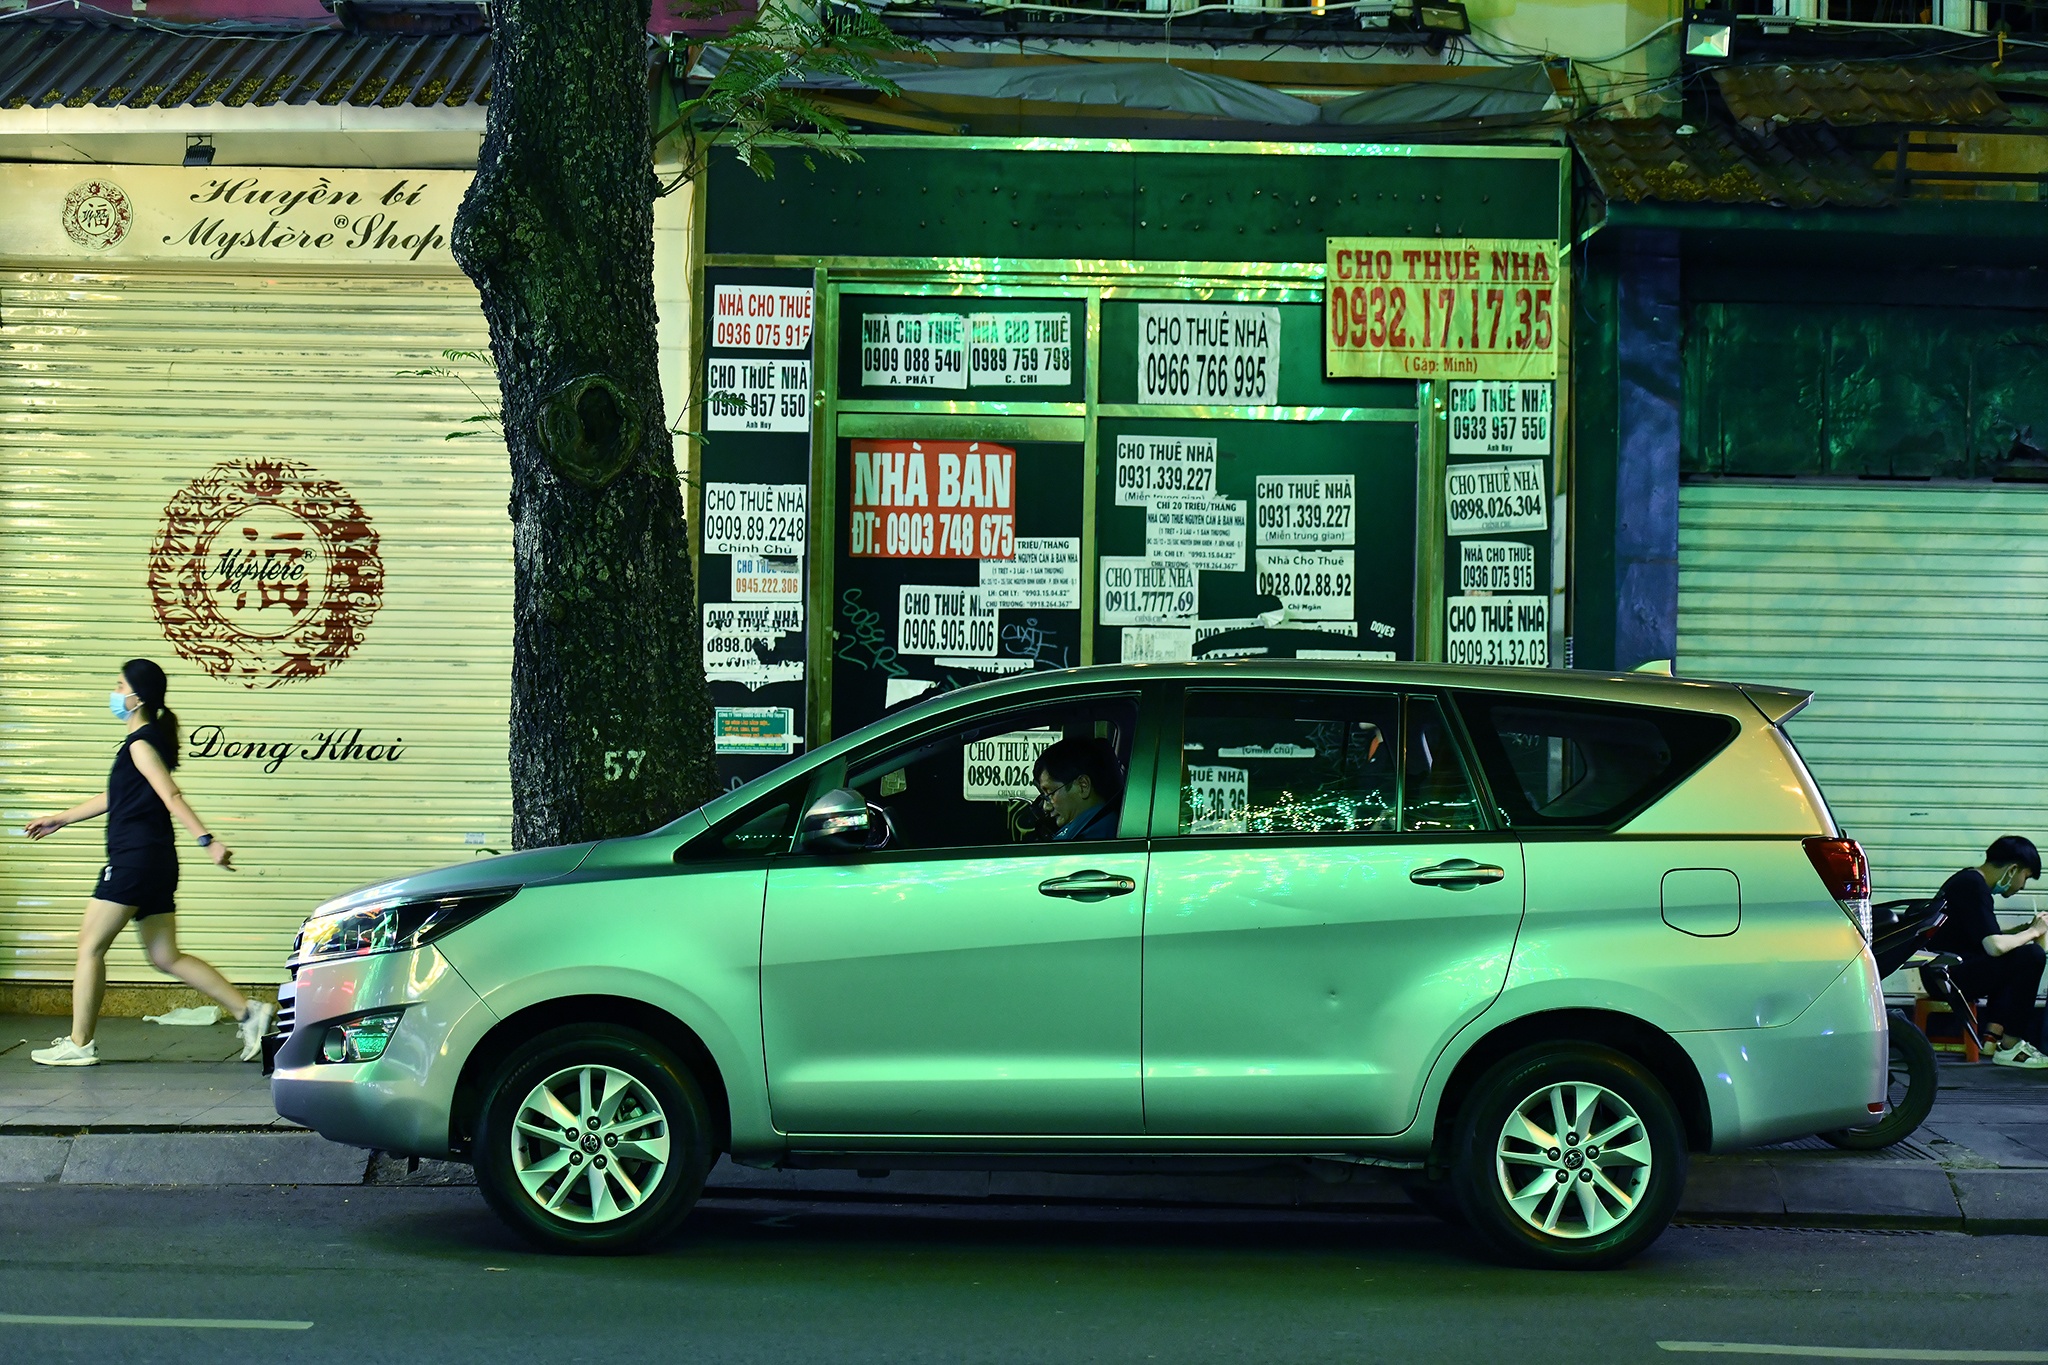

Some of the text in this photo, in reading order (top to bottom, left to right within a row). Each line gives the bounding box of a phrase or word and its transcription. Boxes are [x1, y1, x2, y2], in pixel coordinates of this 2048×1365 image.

[190, 177, 422, 216] Huyền bí
[346, 213, 446, 261] Shop
[1337, 244, 1550, 281] CHO THUÊ NHÀ
[719, 288, 811, 318] NHÀ CHO THUÊ
[864, 316, 962, 344] NHÀ CHO THUÊ
[972, 315, 1069, 344] NHÀ CHO THUÊ
[1146, 311, 1268, 348] CHO THUÊ NHÀ
[1331, 286, 1552, 350] 0932.17.17.35
[717, 322, 810, 347] 0936 075 915
[864, 347, 962, 373] 0909 088 540
[973, 347, 1070, 372] 0989 759 798
[1443, 356, 1478, 374] Minh)
[711, 361, 808, 389] CHO THUÊ NHÀ
[906, 374, 935, 385] PHÁT
[1147, 353, 1266, 398] 0966 766 995
[751, 393, 776, 417] 957
[781, 394, 806, 418] 550
[1451, 384, 1549, 412] CHO THUÊ NHÀ
[1454, 416, 1547, 440] 0933 957 550
[1118, 441, 1213, 462] CHO THUÊ NHÀ
[854, 441, 1012, 508] NHÀ BÁN
[1119, 465, 1212, 491] 0931.339.227
[1450, 464, 1540, 496] CHO THUÊ NHÀ
[708, 486, 804, 512] CHO THUÊ NHÀ
[1257, 479, 1352, 499] CHO THUÊ NHÀ
[1173, 502, 1182, 510] 20
[1259, 505, 1351, 528] 0931.339.227
[1451, 495, 1541, 521] 0898.026.304
[707, 515, 804, 542] 0909.89.2248
[852, 511, 1013, 557] ĐT: 0903 748 675
[1294, 532, 1318, 541] trung
[1321, 531, 1345, 541] gian)
[718, 542, 759, 553] Chính
[1293, 556, 1314, 565] Cho
[1464, 544, 1483, 562] NHÀ
[1486, 548, 1505, 562] CHO
[736, 578, 798, 593] 0945.222.306
[1106, 567, 1131, 587] CHO
[1260, 572, 1351, 597] 0928.02.88.92
[1463, 565, 1532, 588] 0936 075 915
[905, 590, 965, 616] CHO THUÊ
[1106, 590, 1194, 612] 0911.7777.69
[1370, 620, 1396, 637] DOVES
[1449, 599, 1544, 632] CHO THUÊ NHÀ
[903, 618, 994, 651] 0906.905.006
[1450, 640, 1545, 665] 0909.31.32.03
[189, 725, 409, 774] Dong Khoi
[969, 742, 995, 761] CHO
[997, 735, 1030, 762] THUÊ
[604, 750, 646, 780] 57
[968, 765, 1033, 786] 0898.026.
